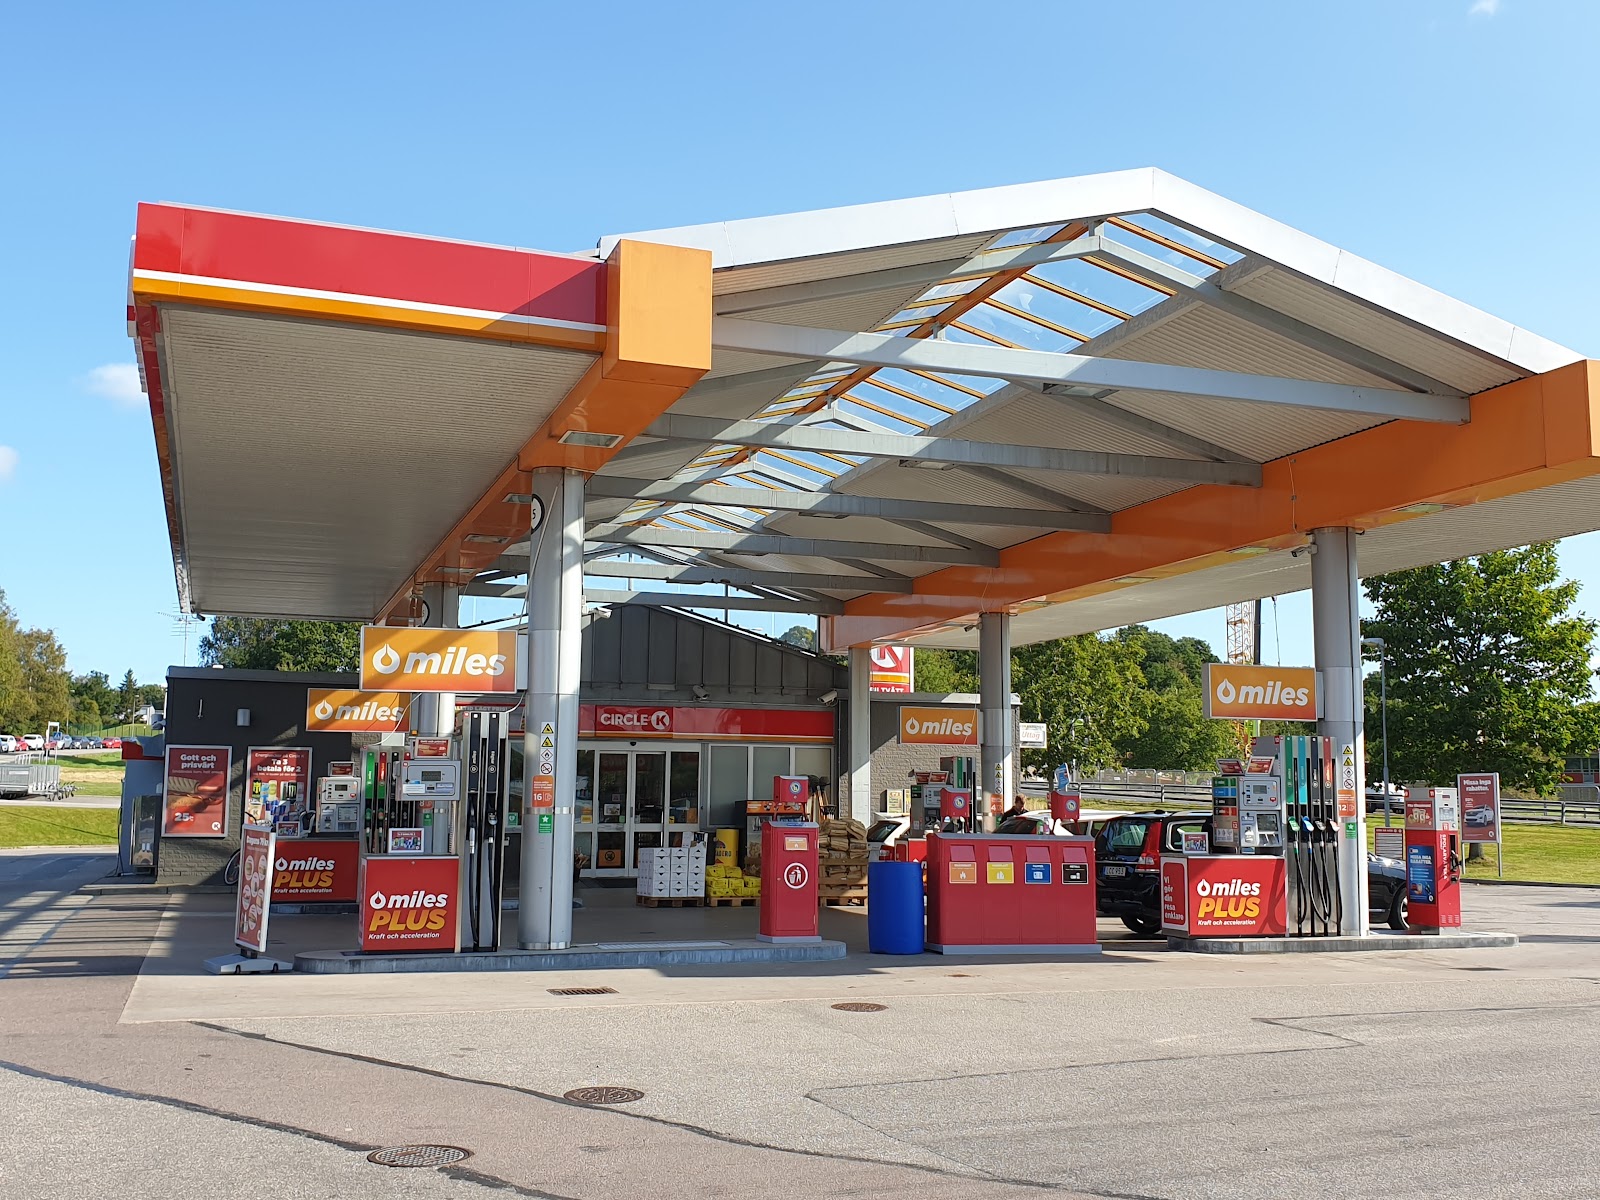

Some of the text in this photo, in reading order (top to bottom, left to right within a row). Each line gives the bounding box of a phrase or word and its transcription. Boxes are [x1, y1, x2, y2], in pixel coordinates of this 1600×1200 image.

[403, 646, 507, 676] miles
[1238, 681, 1310, 706] miles
[335, 702, 404, 722] miles
[600, 714, 648, 725] CIRCLE
[921, 718, 973, 736] miles
[289, 857, 335, 870] miles
[274, 872, 334, 888] PLUS
[1212, 879, 1261, 896] miles
[387, 891, 448, 908] miles
[1198, 897, 1261, 918] PLUS
[369, 910, 447, 931] PLUS
[1165, 912, 1184, 920] enklare
